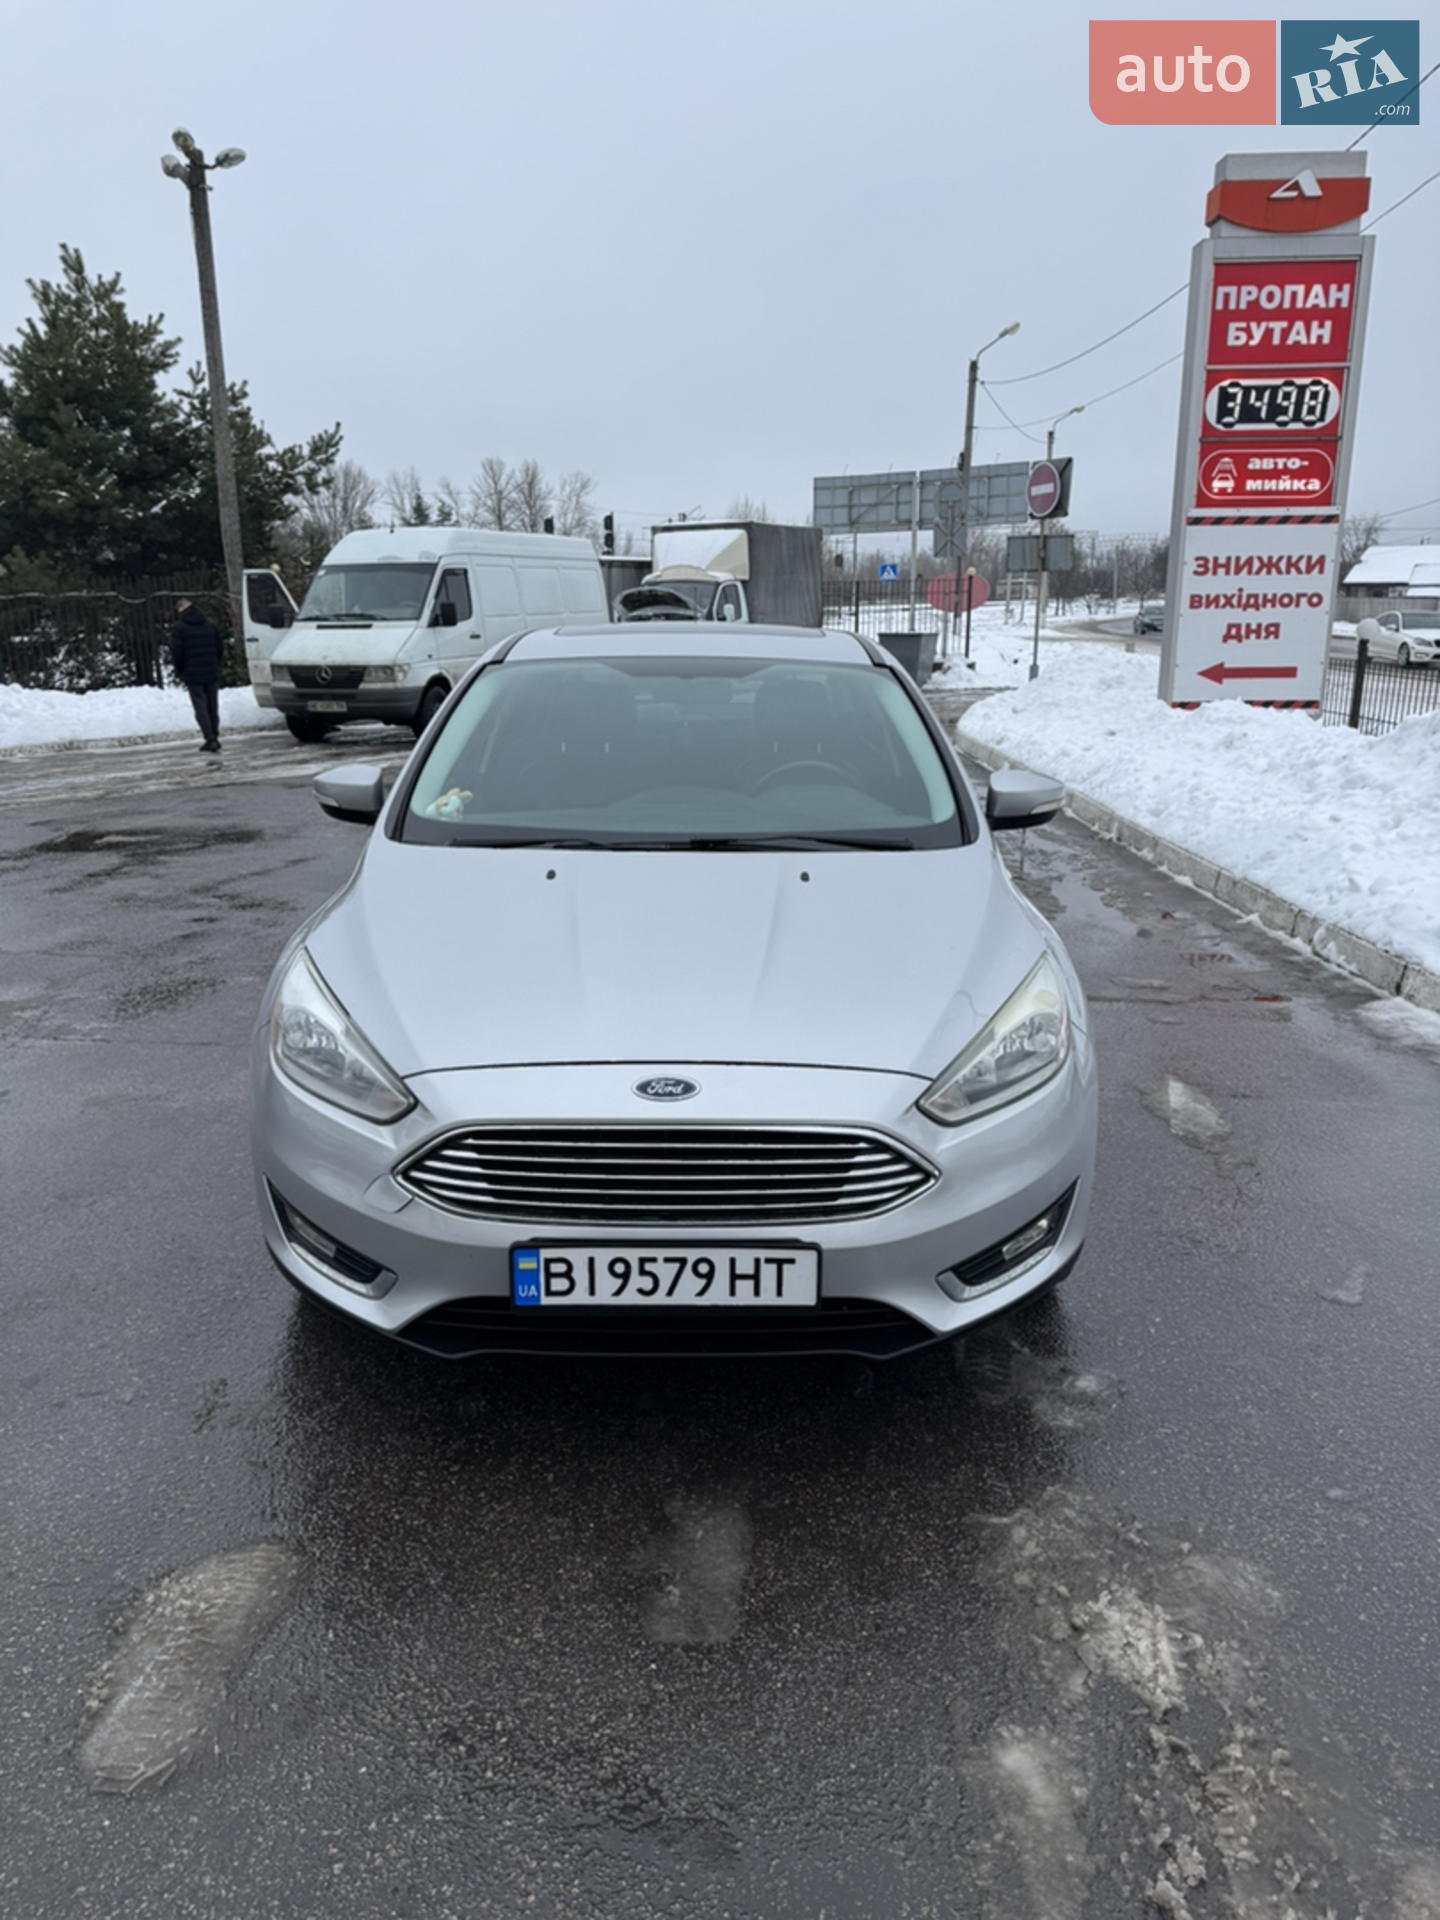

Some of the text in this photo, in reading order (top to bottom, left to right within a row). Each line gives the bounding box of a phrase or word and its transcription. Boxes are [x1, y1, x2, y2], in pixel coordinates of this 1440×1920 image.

[1215, 283, 1351, 310] ПРОПАН
[1226, 320, 1332, 346] БУТАН
[1247, 456, 1309, 470] авто-
[1245, 474, 1321, 491] мийка
[1188, 588, 1324, 611] вихідного
[646, 1079, 686, 1095] Ford
[518, 1284, 538, 1297] UA
